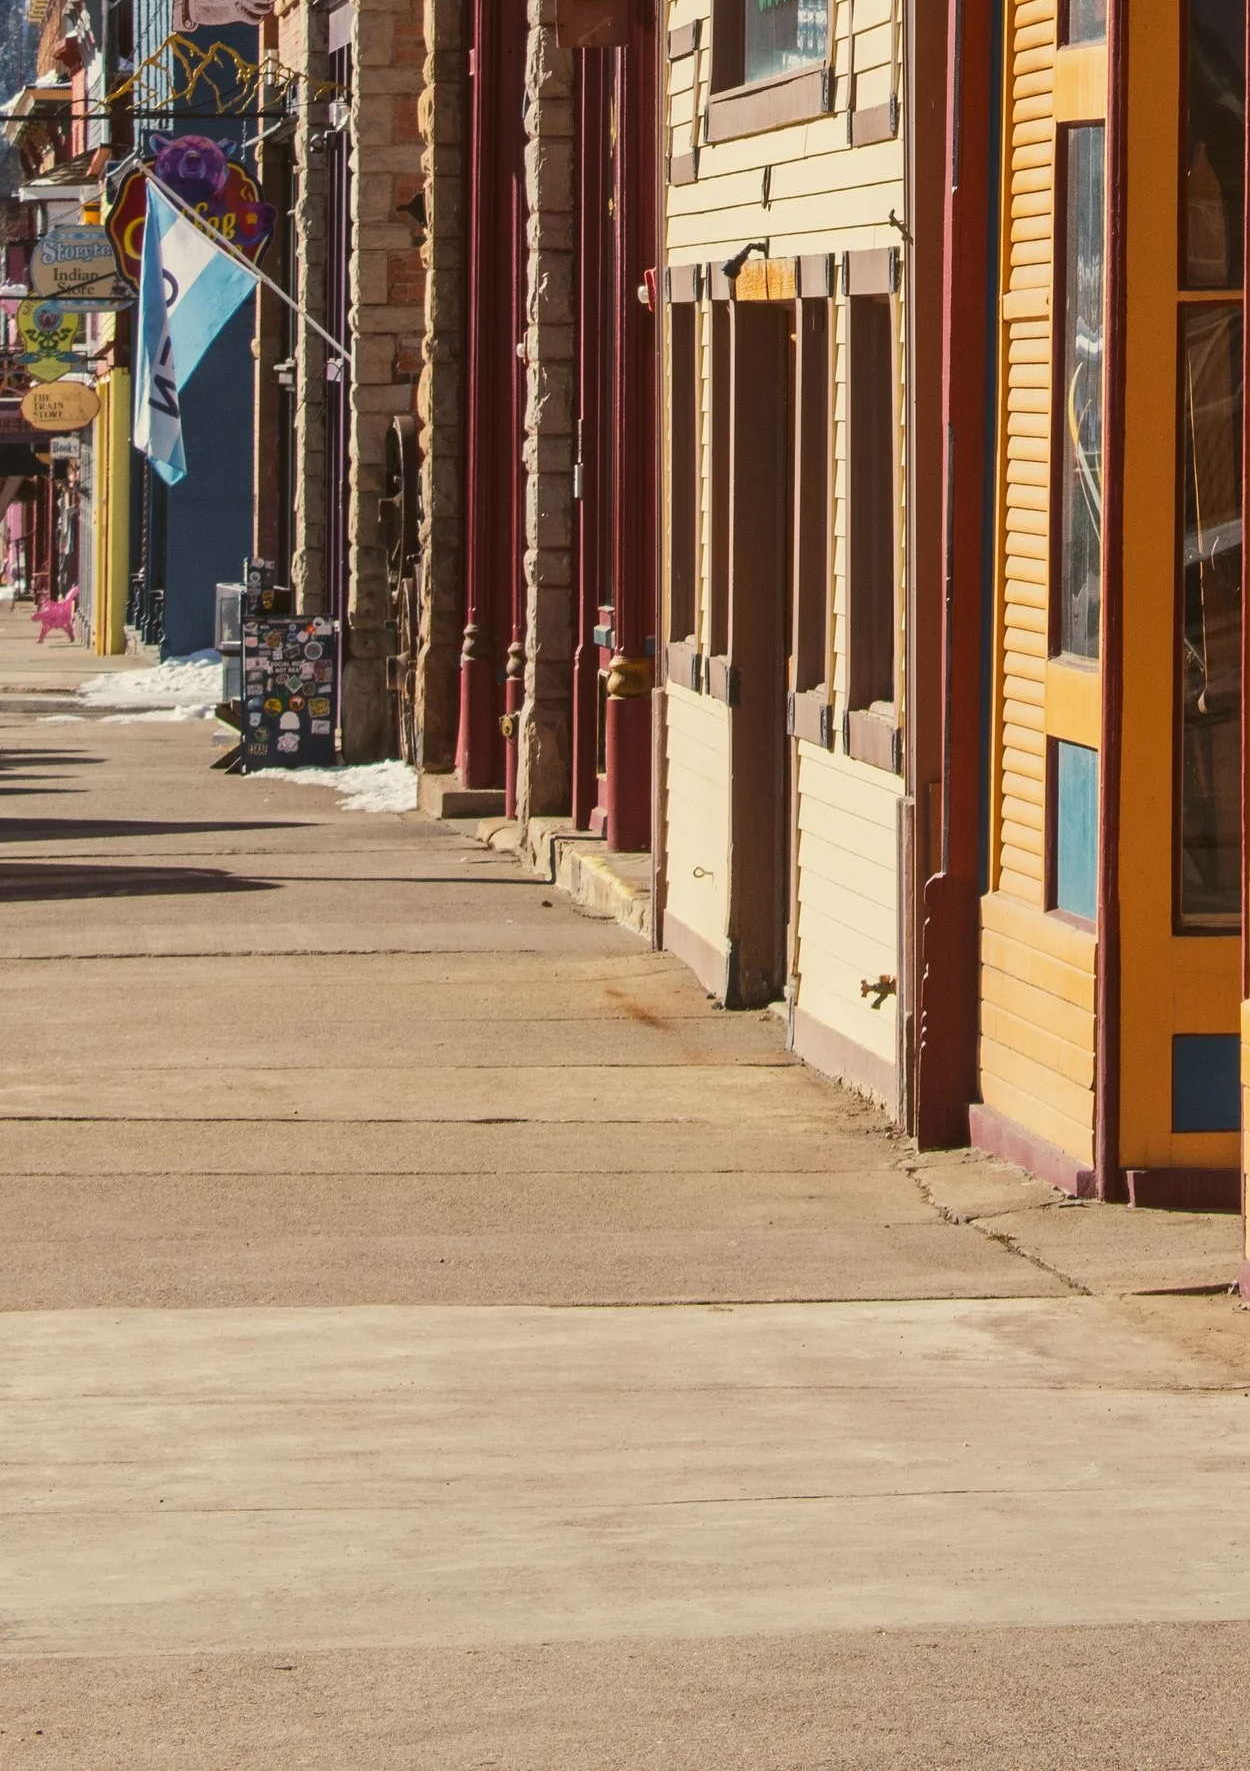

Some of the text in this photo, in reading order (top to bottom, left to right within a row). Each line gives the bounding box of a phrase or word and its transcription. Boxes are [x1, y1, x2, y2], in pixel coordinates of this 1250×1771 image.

[53, 267, 99, 282] Indian
[32, 402, 64, 411] TRAIN
[32, 411, 63, 419] STORE
